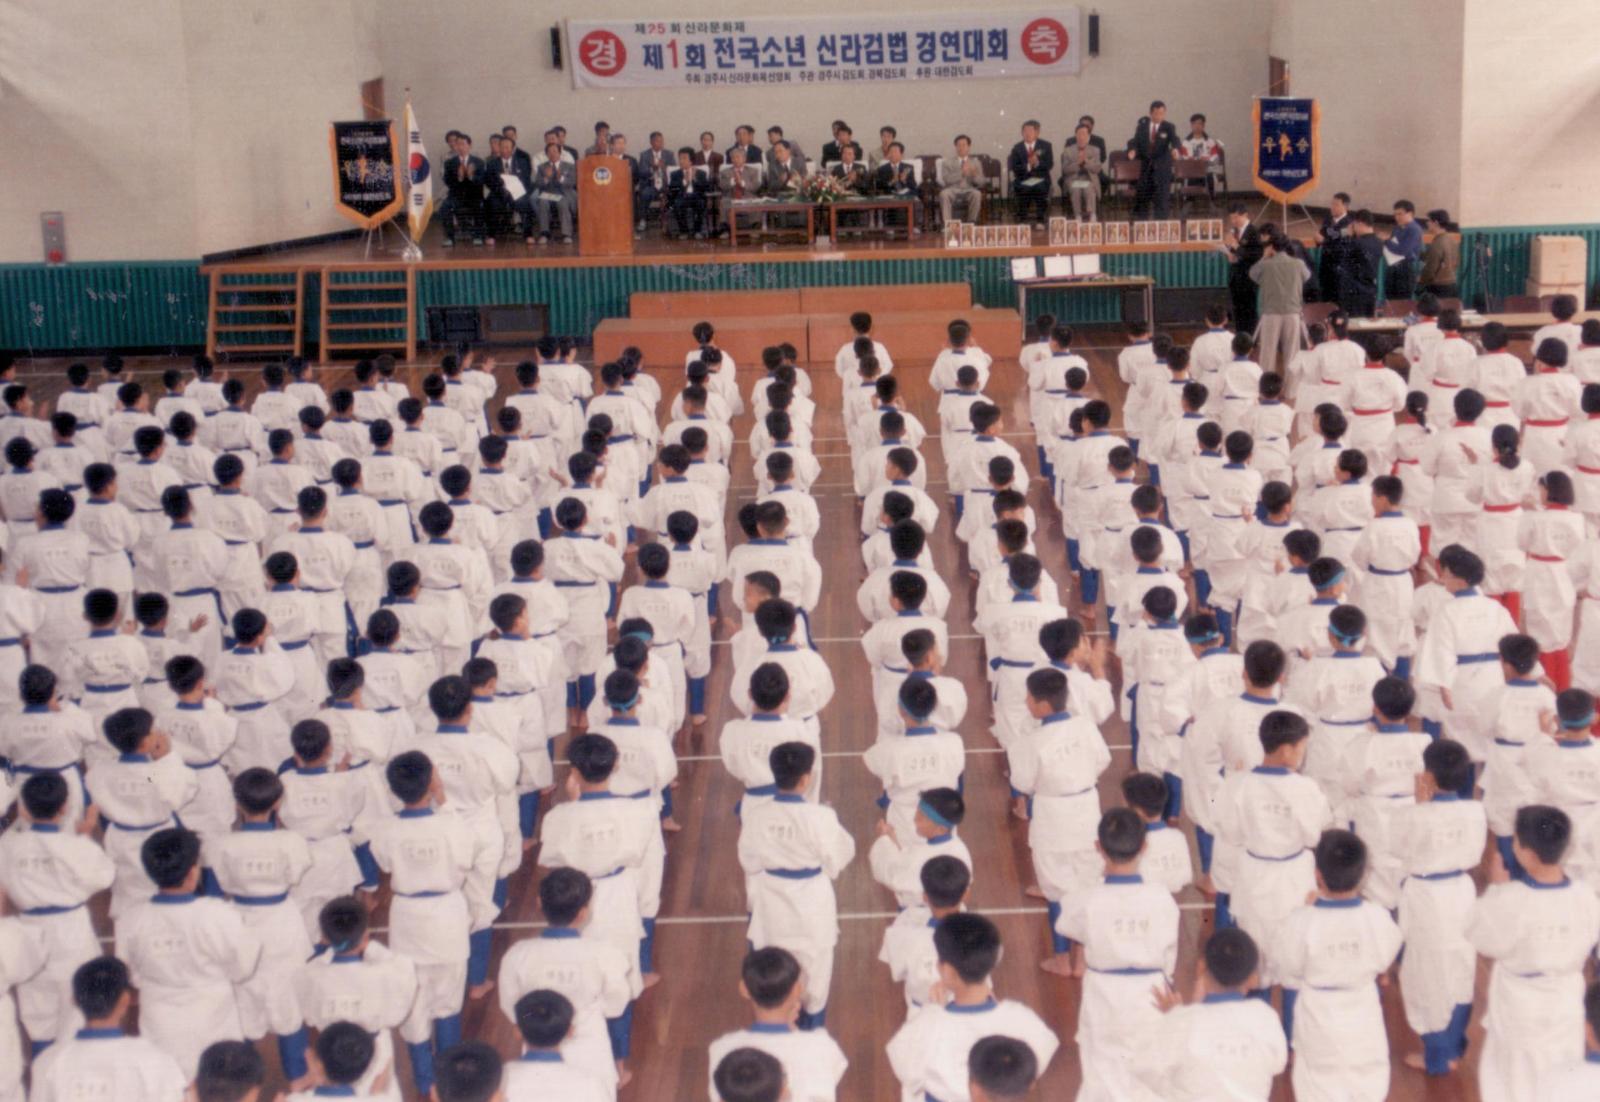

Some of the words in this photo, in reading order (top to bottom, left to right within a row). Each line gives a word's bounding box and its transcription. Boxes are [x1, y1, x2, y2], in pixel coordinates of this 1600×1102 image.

[685, 20, 745, 34] 신라문화제
[1029, 26, 1060, 58] 축
[587, 38, 617, 69] 경
[713, 35, 807, 69] 전국소년
[816, 31, 909, 66] 신라검법
[916, 28, 1009, 63] 경연대회
